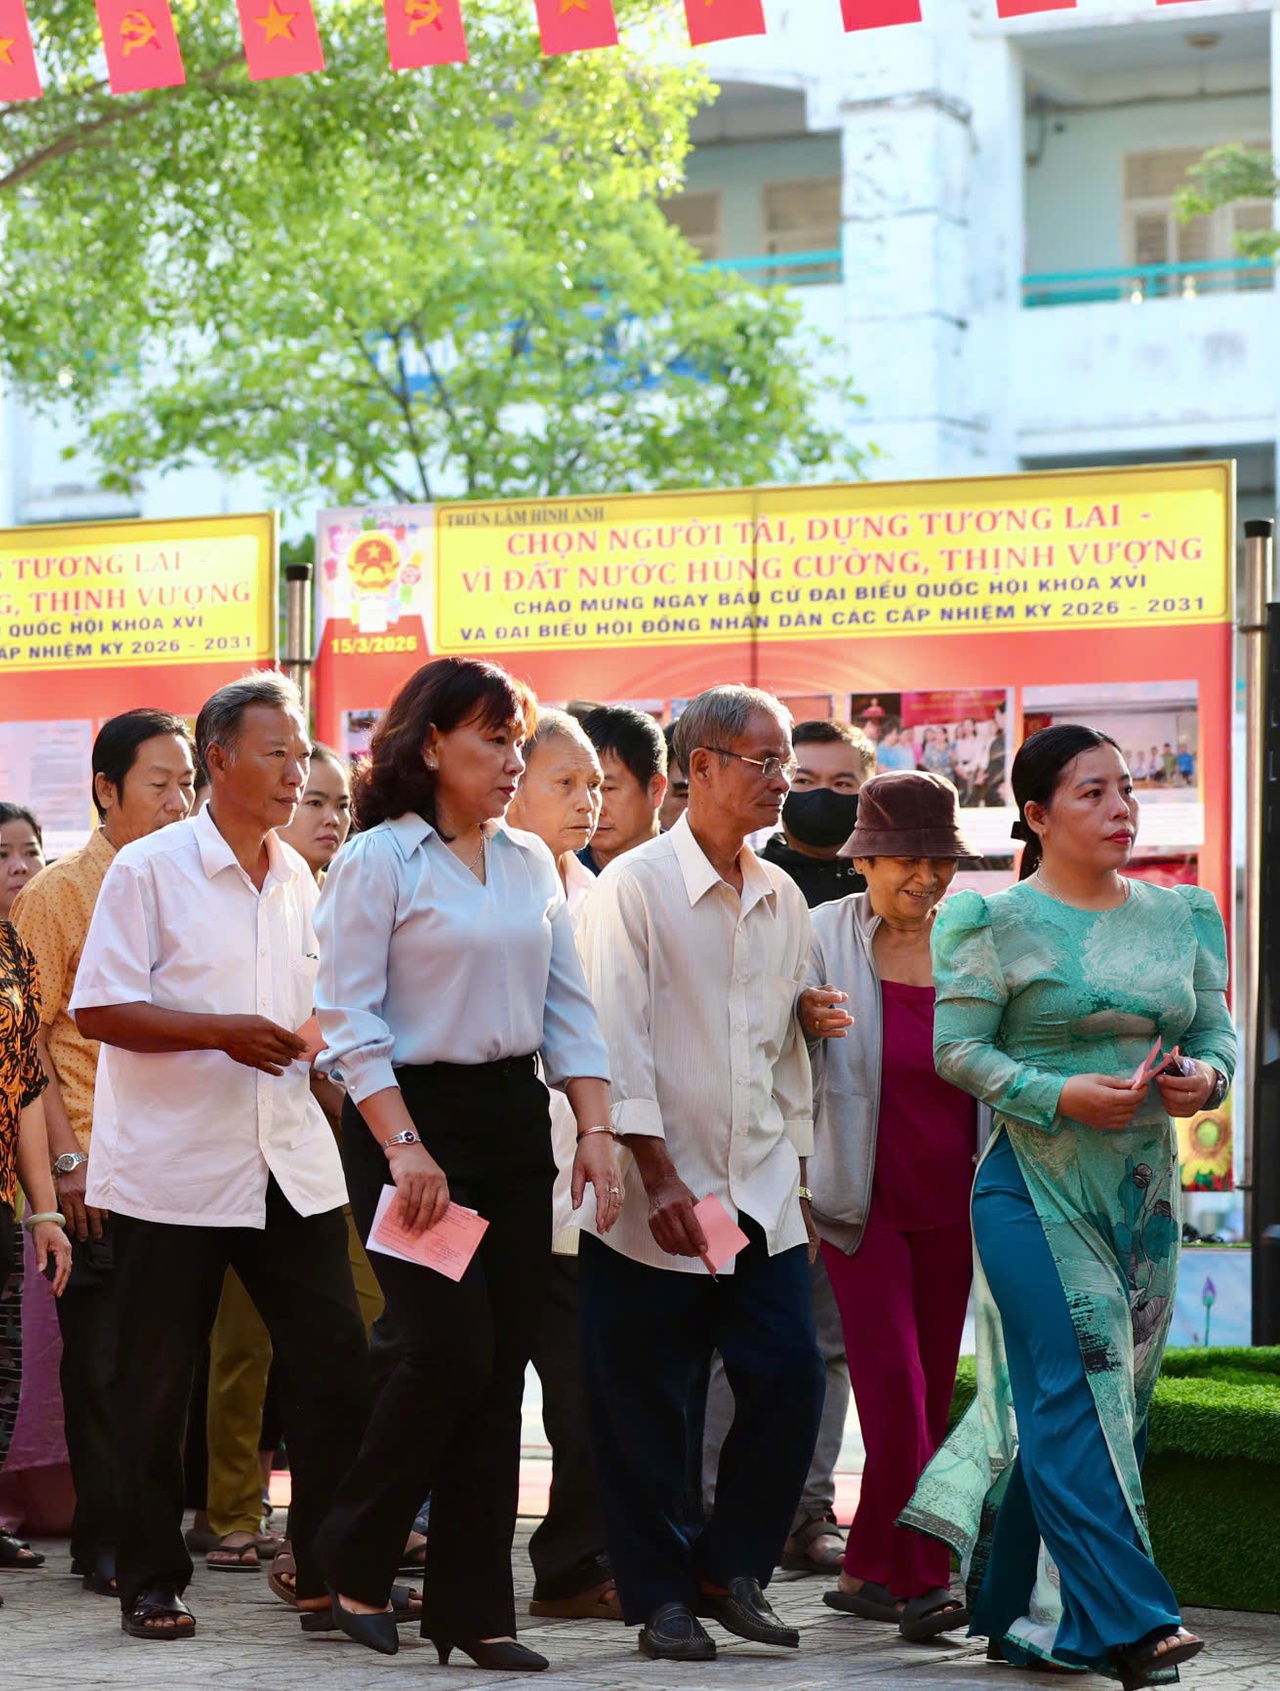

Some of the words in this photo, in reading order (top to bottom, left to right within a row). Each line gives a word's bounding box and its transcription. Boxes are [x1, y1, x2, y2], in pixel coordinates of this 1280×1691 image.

[506, 529, 598, 559] CHỌN
[608, 517, 722, 550] NGƯỜI
[733, 514, 796, 547] TÀI,
[806, 514, 909, 546] DỰNG
[919, 506, 1053, 537] TƯƠNG
[1064, 503, 1121, 530] LAI
[11, 553, 124, 581] TƯƠNG
[460, 564, 492, 594] VÌ
[503, 560, 569, 592] ĐẤT
[577, 557, 677, 589] NƯỚC
[687, 553, 782, 584] HÙNG
[792, 547, 930, 579] CƯỜNG,
[939, 544, 1055, 576] THỊNH
[1067, 536, 1203, 570] VƯỢNG
[1109, 574, 1147, 590] XVI
[28, 588, 126, 617] THỊNH
[1061, 600, 1120, 617] 2026
[1147, 596, 1205, 613] 2031
[171, 615, 203, 630] XVI
[131, 639, 181, 655] 2026
[203, 635, 252, 651] 2031
[330, 635, 418, 655] 15/3/2026
